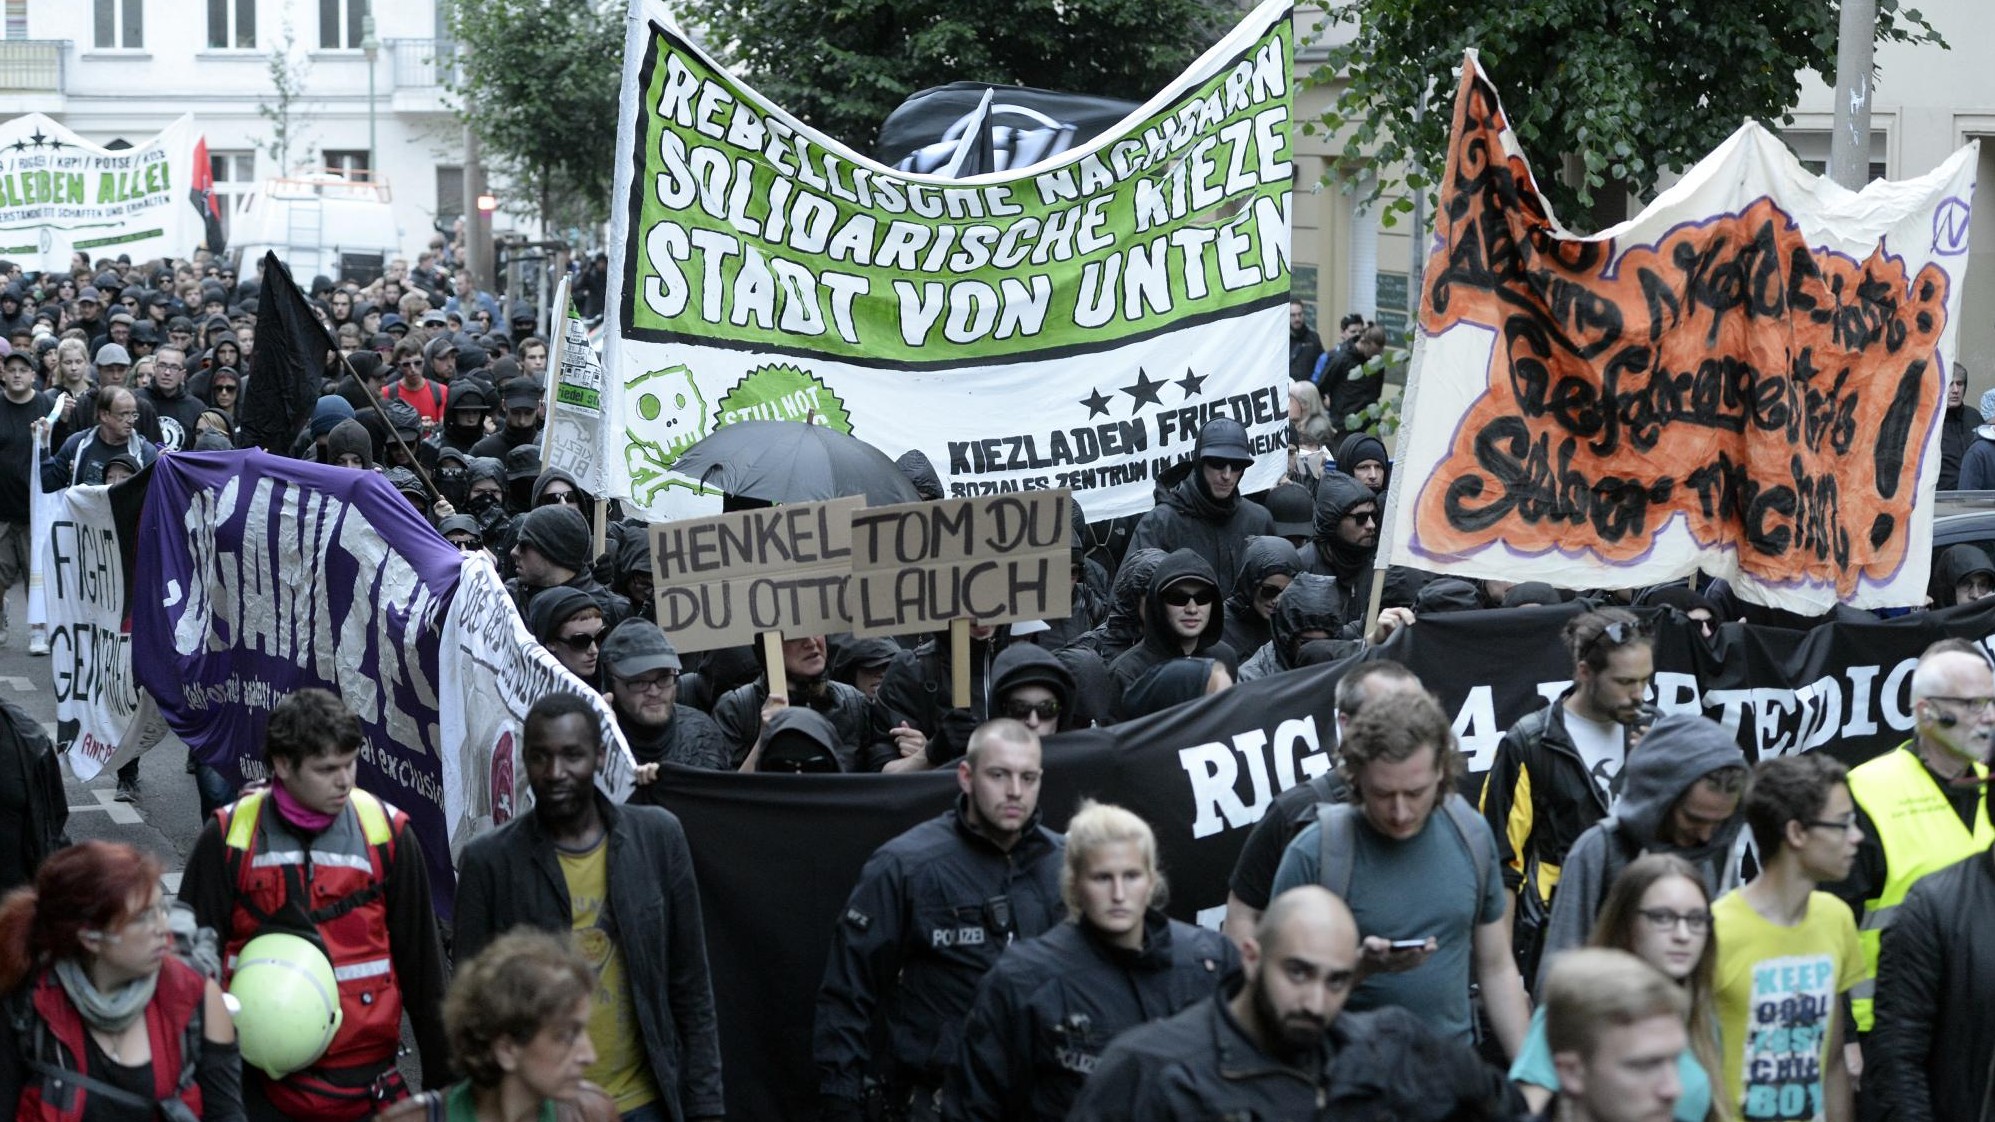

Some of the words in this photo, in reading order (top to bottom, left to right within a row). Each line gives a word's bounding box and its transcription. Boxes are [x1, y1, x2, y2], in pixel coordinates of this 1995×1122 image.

[658, 52, 1024, 219] REBELLISCHE
[1037, 36, 1287, 205] NACHBARN
[97, 161, 170, 204] ALLE!
[656, 128, 1117, 274] SOLIDARISCHE
[1133, 107, 1292, 233] KIEZE
[644, 220, 869, 345] STADT
[894, 274, 1052, 347] VON
[1073, 191, 1292, 331] UNTEN
[780, 386, 820, 418] NOT
[948, 417, 1147, 475] KIEZLADEN
[1156, 385, 1289, 448] FRIEDEL
[1055, 459, 1147, 491] ZENTRUM
[657, 502, 851, 579] HENKEL
[851, 501, 973, 564] TOM
[985, 495, 1063, 553] DU
[51, 521, 116, 613] FIGHT
[860, 558, 1048, 627] LAUCH
[662, 579, 731, 632] DU
[378, 748, 445, 813] exclusio
[933, 926, 985, 948] POIZEI
[1756, 961, 1833, 995] KEEP
